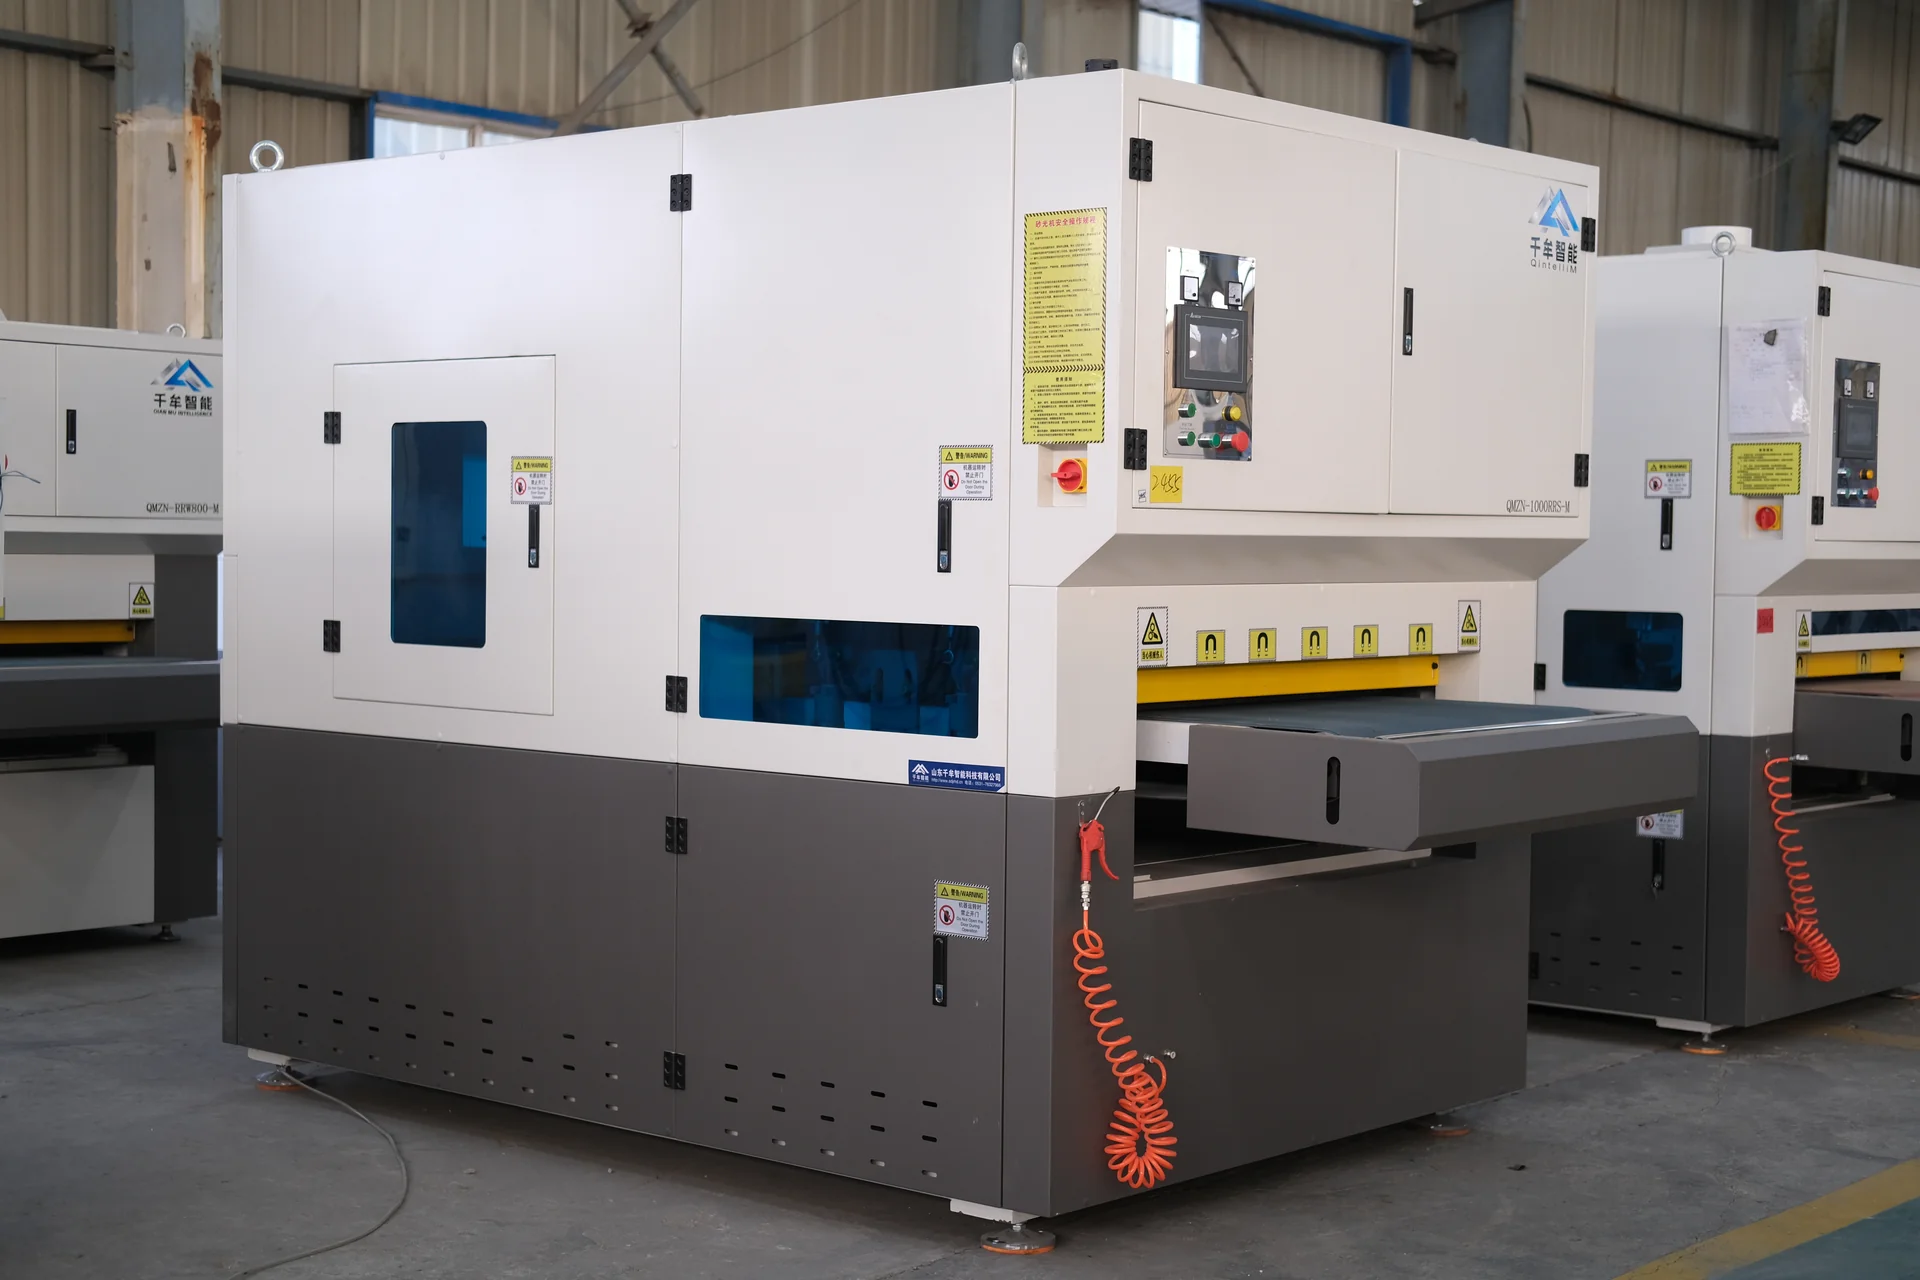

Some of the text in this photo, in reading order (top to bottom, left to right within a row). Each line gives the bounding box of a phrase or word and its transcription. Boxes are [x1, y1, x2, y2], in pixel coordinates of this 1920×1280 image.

[1530, 236, 1578, 264] 千牟智能
[1530, 258, 1577, 274] QintelliM
[153, 393, 213, 411] 千牟智能
[146, 502, 219, 514] QMZN-RRW800-M
[1506, 499, 1570, 513] QMZN-1000RRS-M
[931, 768, 1001, 782] 山东千牟智能科技有限公司
